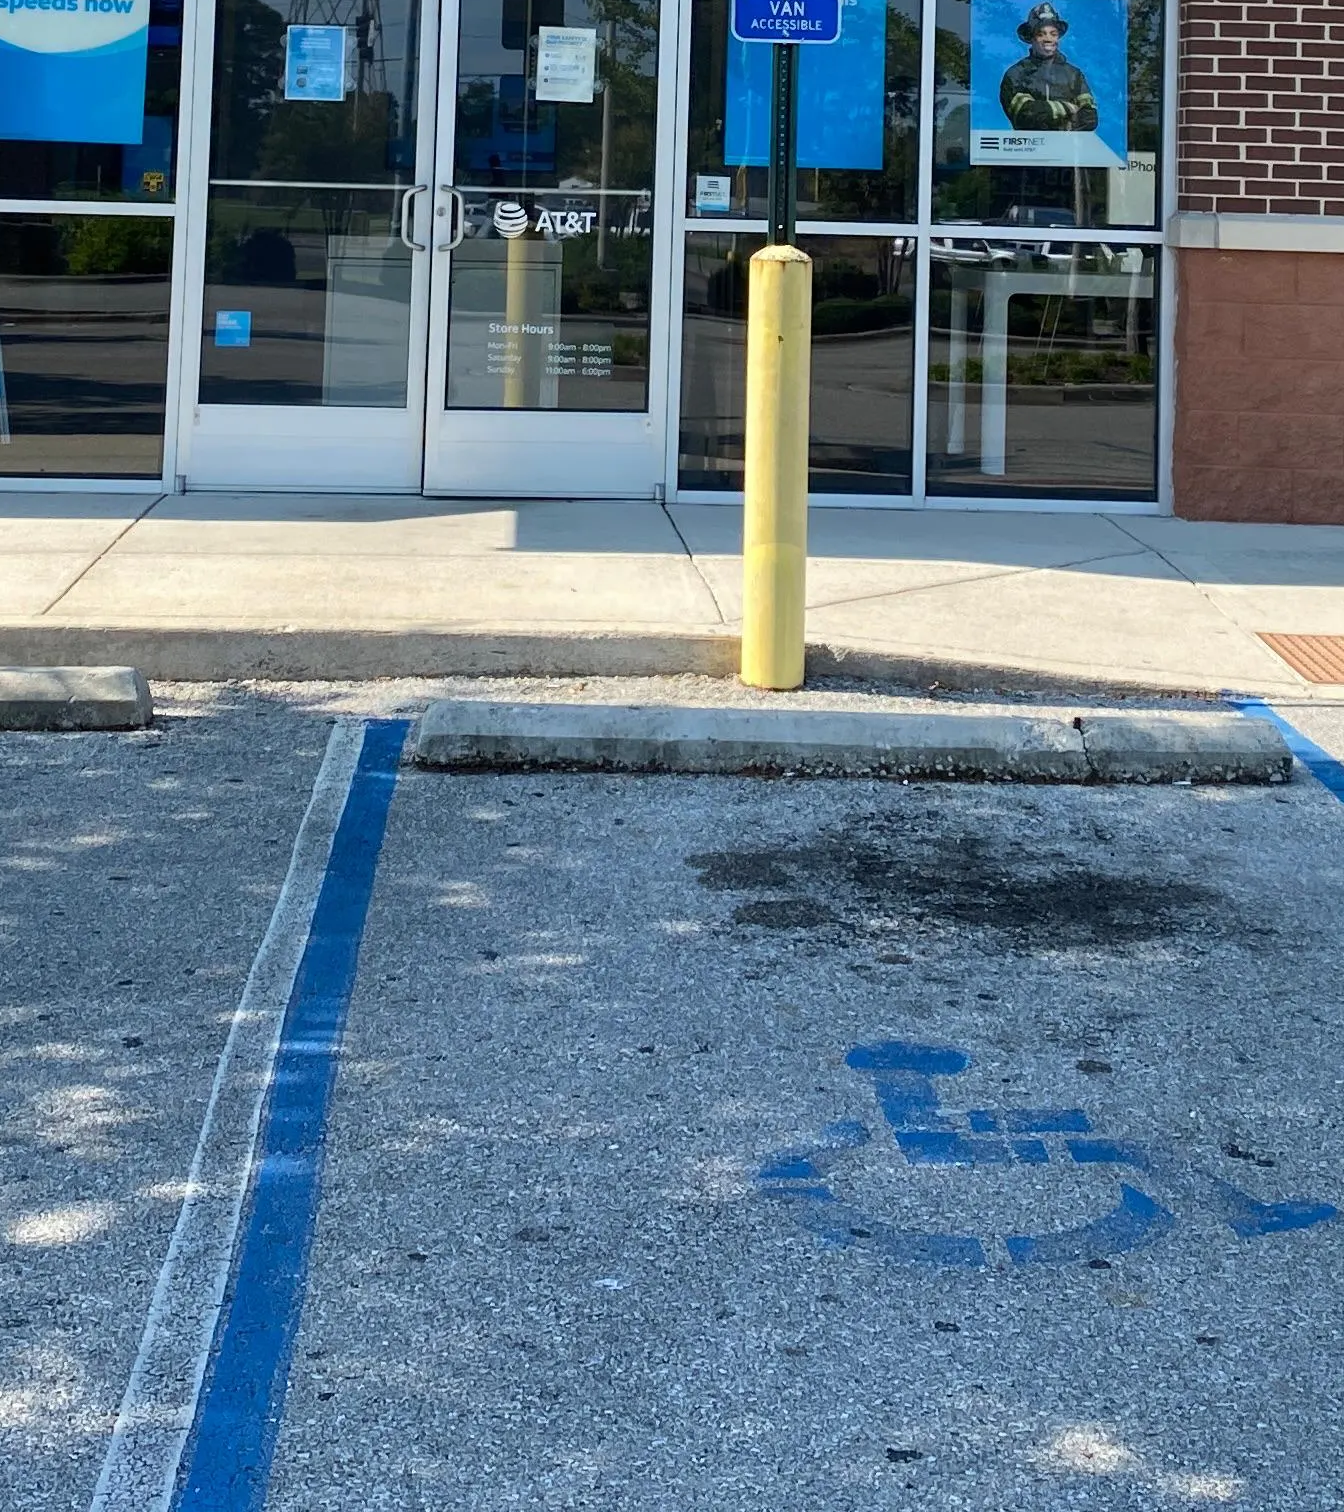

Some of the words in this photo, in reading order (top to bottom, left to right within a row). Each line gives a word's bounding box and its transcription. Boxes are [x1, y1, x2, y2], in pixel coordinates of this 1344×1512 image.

[770, 1, 804, 16] VAN
[751, 19, 822, 31] ACCESSIBLE
[1127, 160, 1156, 171] iPho
[535, 211, 596, 233] AT&T
[488, 323, 519, 334] Store
[521, 324, 554, 335] Hours
[487, 354, 522, 364] Saturday
[582, 356, 611, 365] 8:00pm
[487, 366, 515, 375] Sunday
